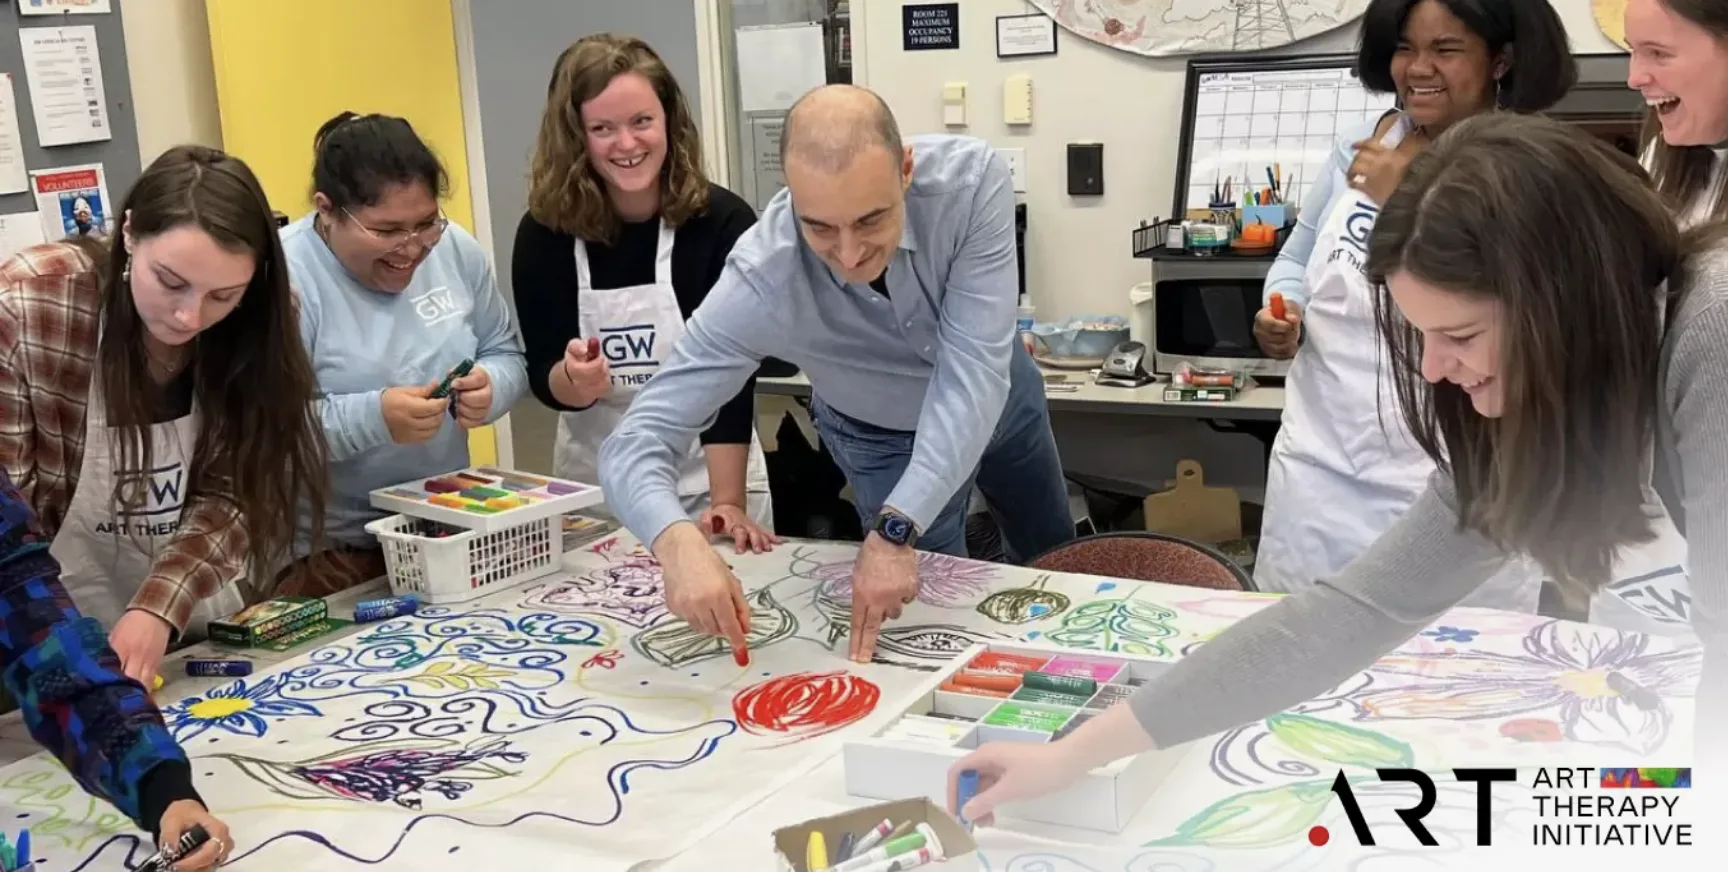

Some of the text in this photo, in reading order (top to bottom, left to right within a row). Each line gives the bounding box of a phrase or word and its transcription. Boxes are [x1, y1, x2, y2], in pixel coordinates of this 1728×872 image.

[912, 18, 950, 27] MAXIMUM
[908, 26, 952, 36] OCCUPANCY
[919, 35, 951, 44] PERSONS
[1346, 212, 1374, 243] G
[416, 290, 455, 320] GW
[602, 331, 655, 361] GW
[134, 520, 179, 536] THER
